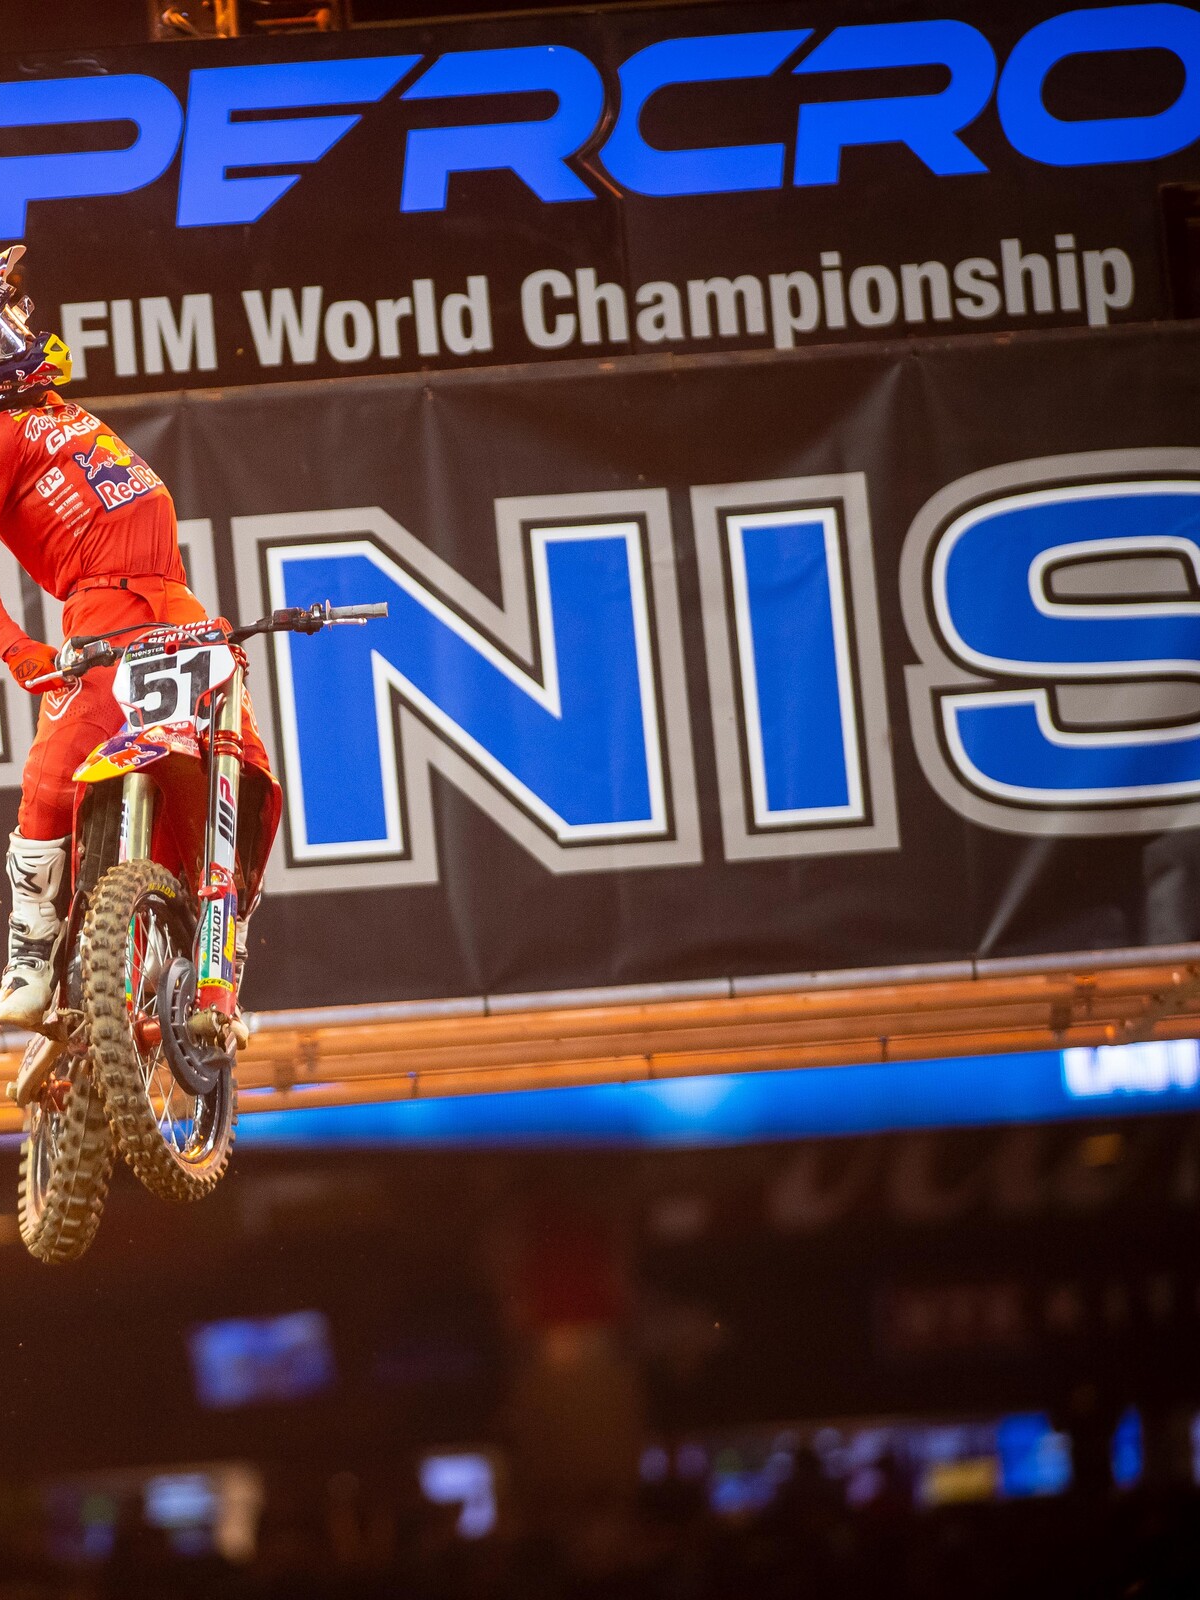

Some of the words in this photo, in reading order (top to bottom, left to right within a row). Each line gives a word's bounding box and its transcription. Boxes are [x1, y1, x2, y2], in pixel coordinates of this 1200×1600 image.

[61, 294, 217, 380] FIM
[243, 275, 493, 366] World
[521, 234, 1134, 349] Championship
[37, 469, 63, 495] PPG
[95, 467, 149, 510] Red
[129, 650, 212, 728] 51
[211, 905, 222, 966] DUNLOP
